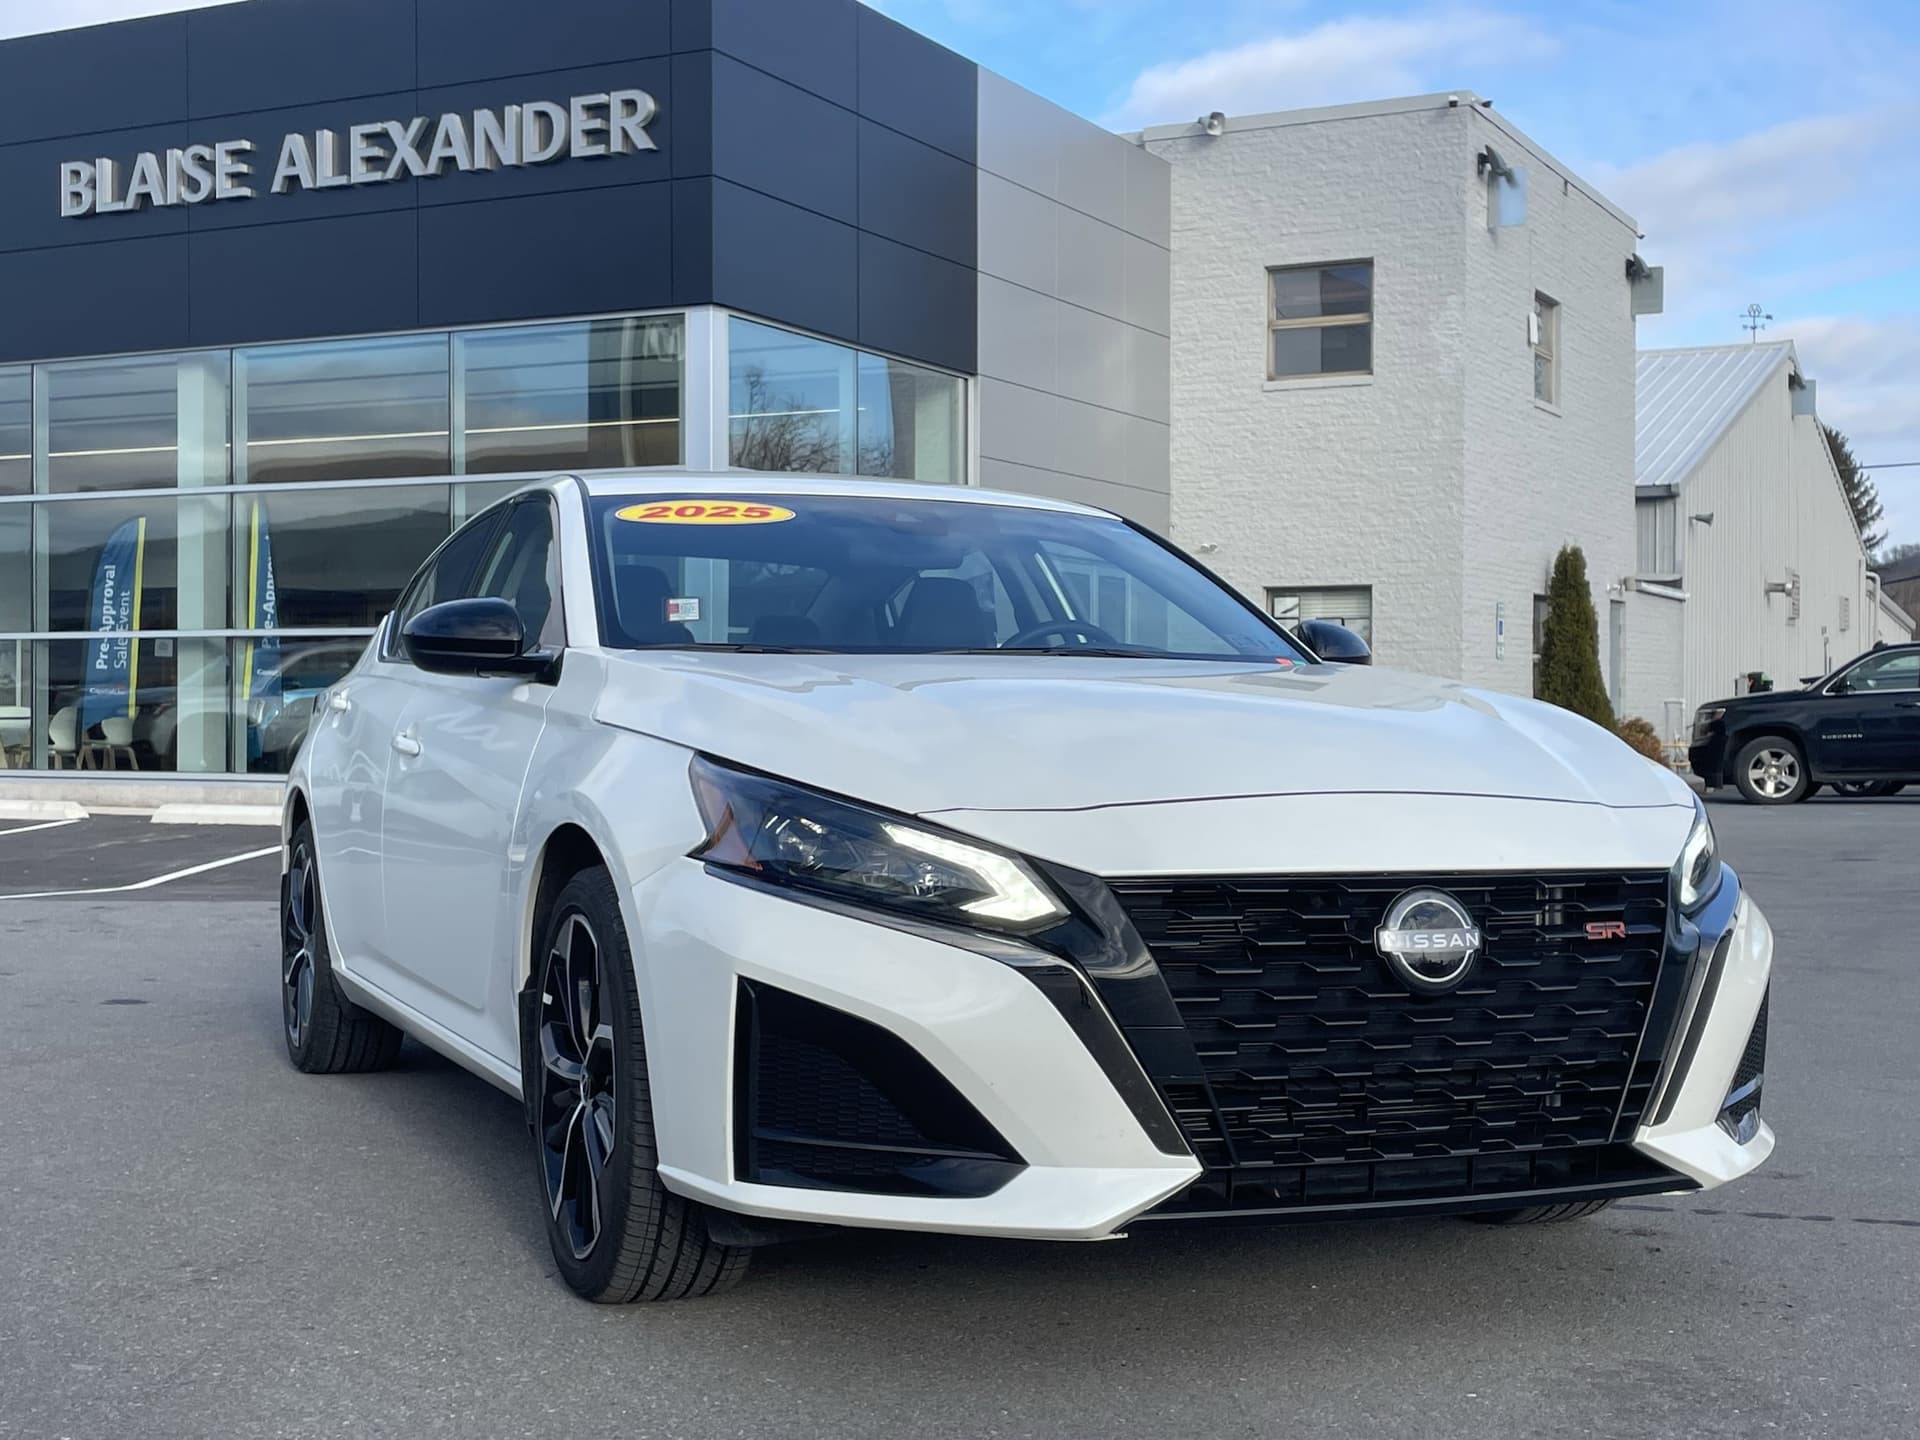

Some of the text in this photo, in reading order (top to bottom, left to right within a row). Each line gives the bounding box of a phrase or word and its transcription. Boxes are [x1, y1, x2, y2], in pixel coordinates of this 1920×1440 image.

[60, 88, 659, 217] BLAISE ALEXANDER
[637, 506, 773, 519] 2025
[1585, 921, 1626, 940] SR
[1382, 932, 1480, 949] NISSAN
